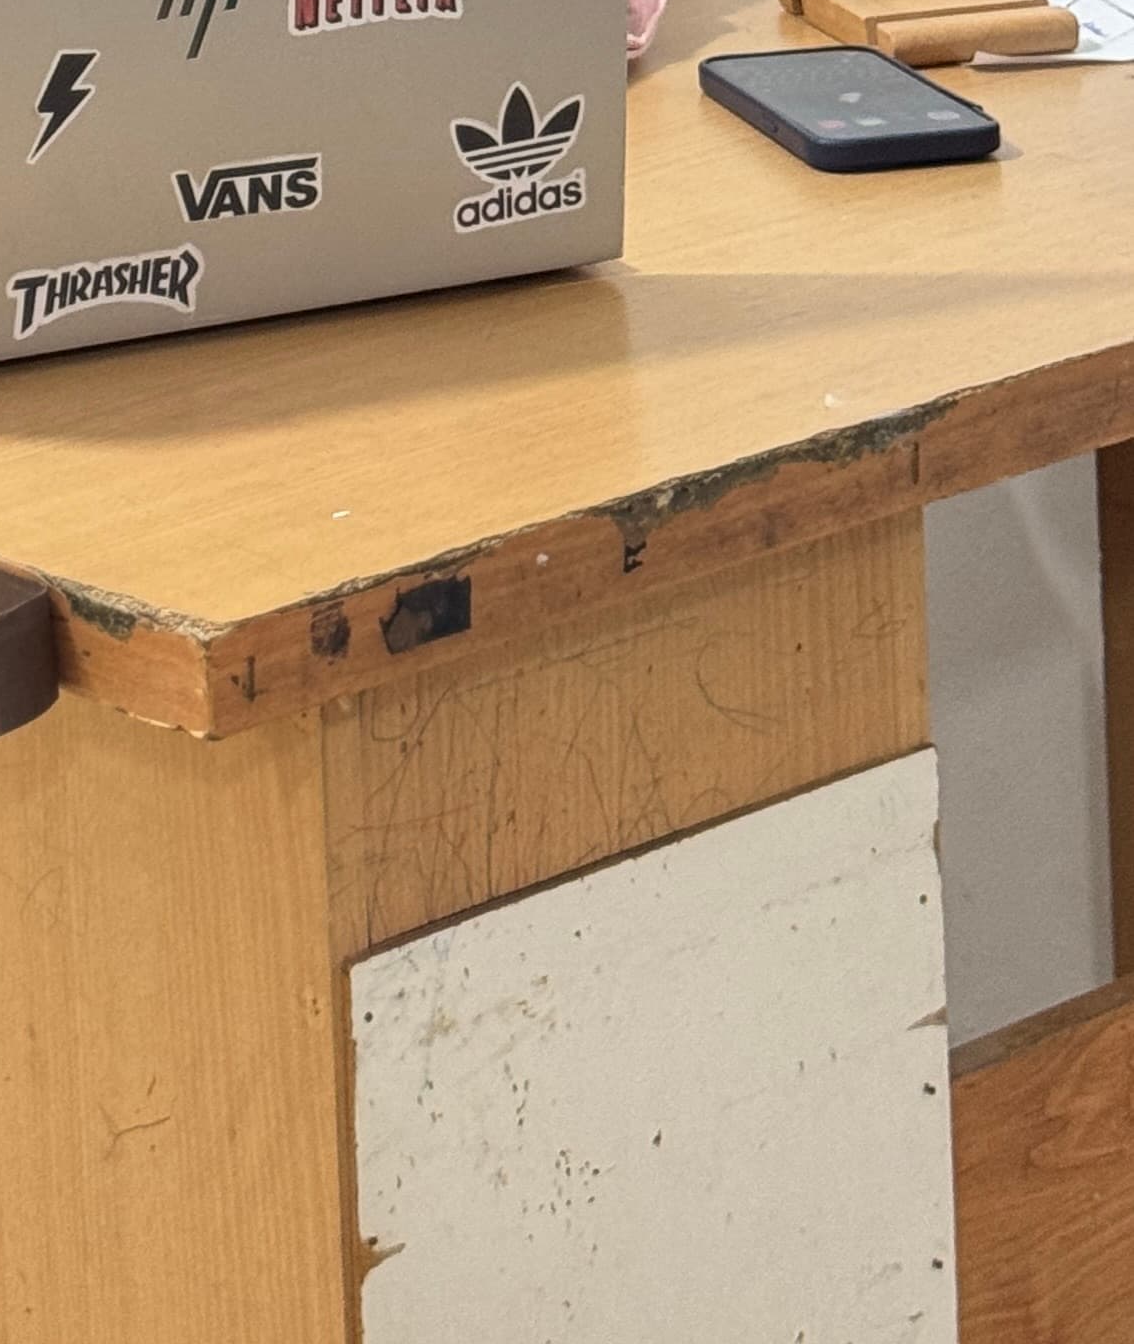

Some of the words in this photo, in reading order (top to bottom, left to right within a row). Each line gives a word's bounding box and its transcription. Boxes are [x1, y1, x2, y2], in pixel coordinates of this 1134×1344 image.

[175, 156, 320, 222] VANS
[457, 181, 583, 228] adidas
[11, 248, 200, 334] THRASHER
